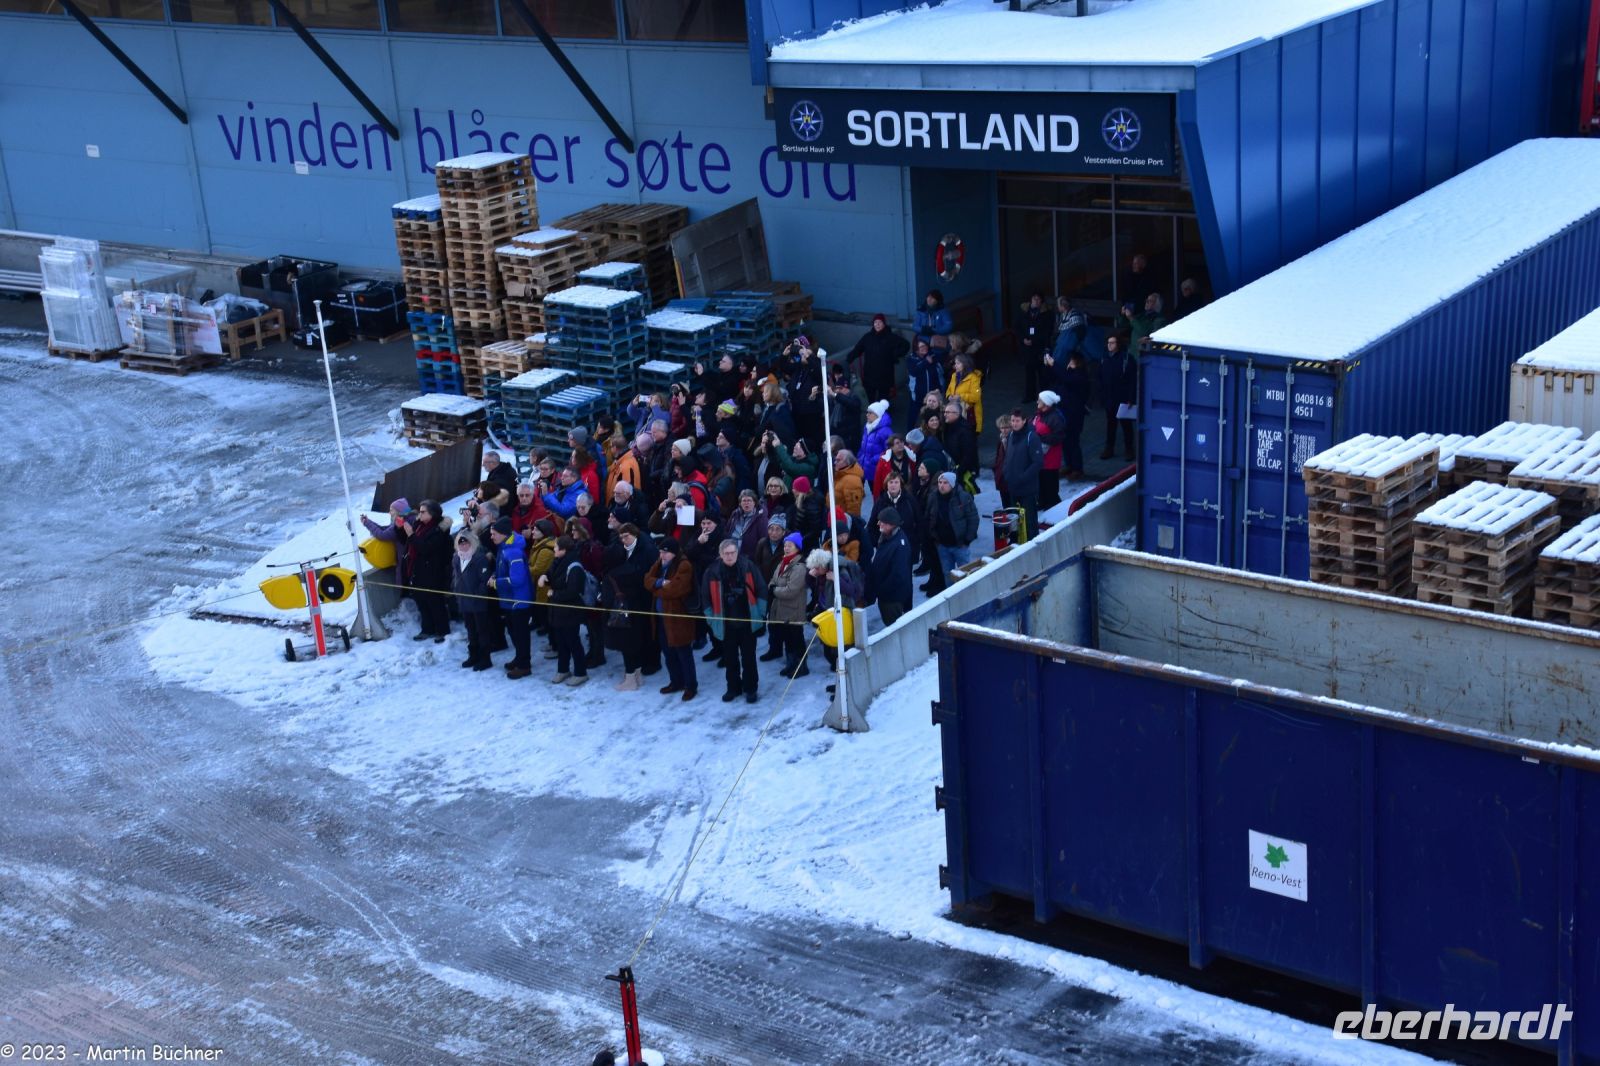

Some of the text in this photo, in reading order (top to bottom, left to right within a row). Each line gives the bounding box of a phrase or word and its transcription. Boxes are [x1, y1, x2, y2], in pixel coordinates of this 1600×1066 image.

[847, 109, 1080, 153] SORTLAND
[217, 101, 392, 172] vinden
[604, 130, 732, 195] søte
[782, 144, 835, 154] Sortland Havn KF
[1122, 156, 1146, 166] Cruise
[1147, 157, 1165, 167] Port
[1265, 389, 1285, 401] MTBU
[1294, 393, 1324, 406] 040816
[1294, 405, 1314, 418] 45G1
[1257, 439, 1274, 450] TARE
[1257, 448, 1269, 459] NET
[1251, 866, 1303, 889] Reno-Vest
